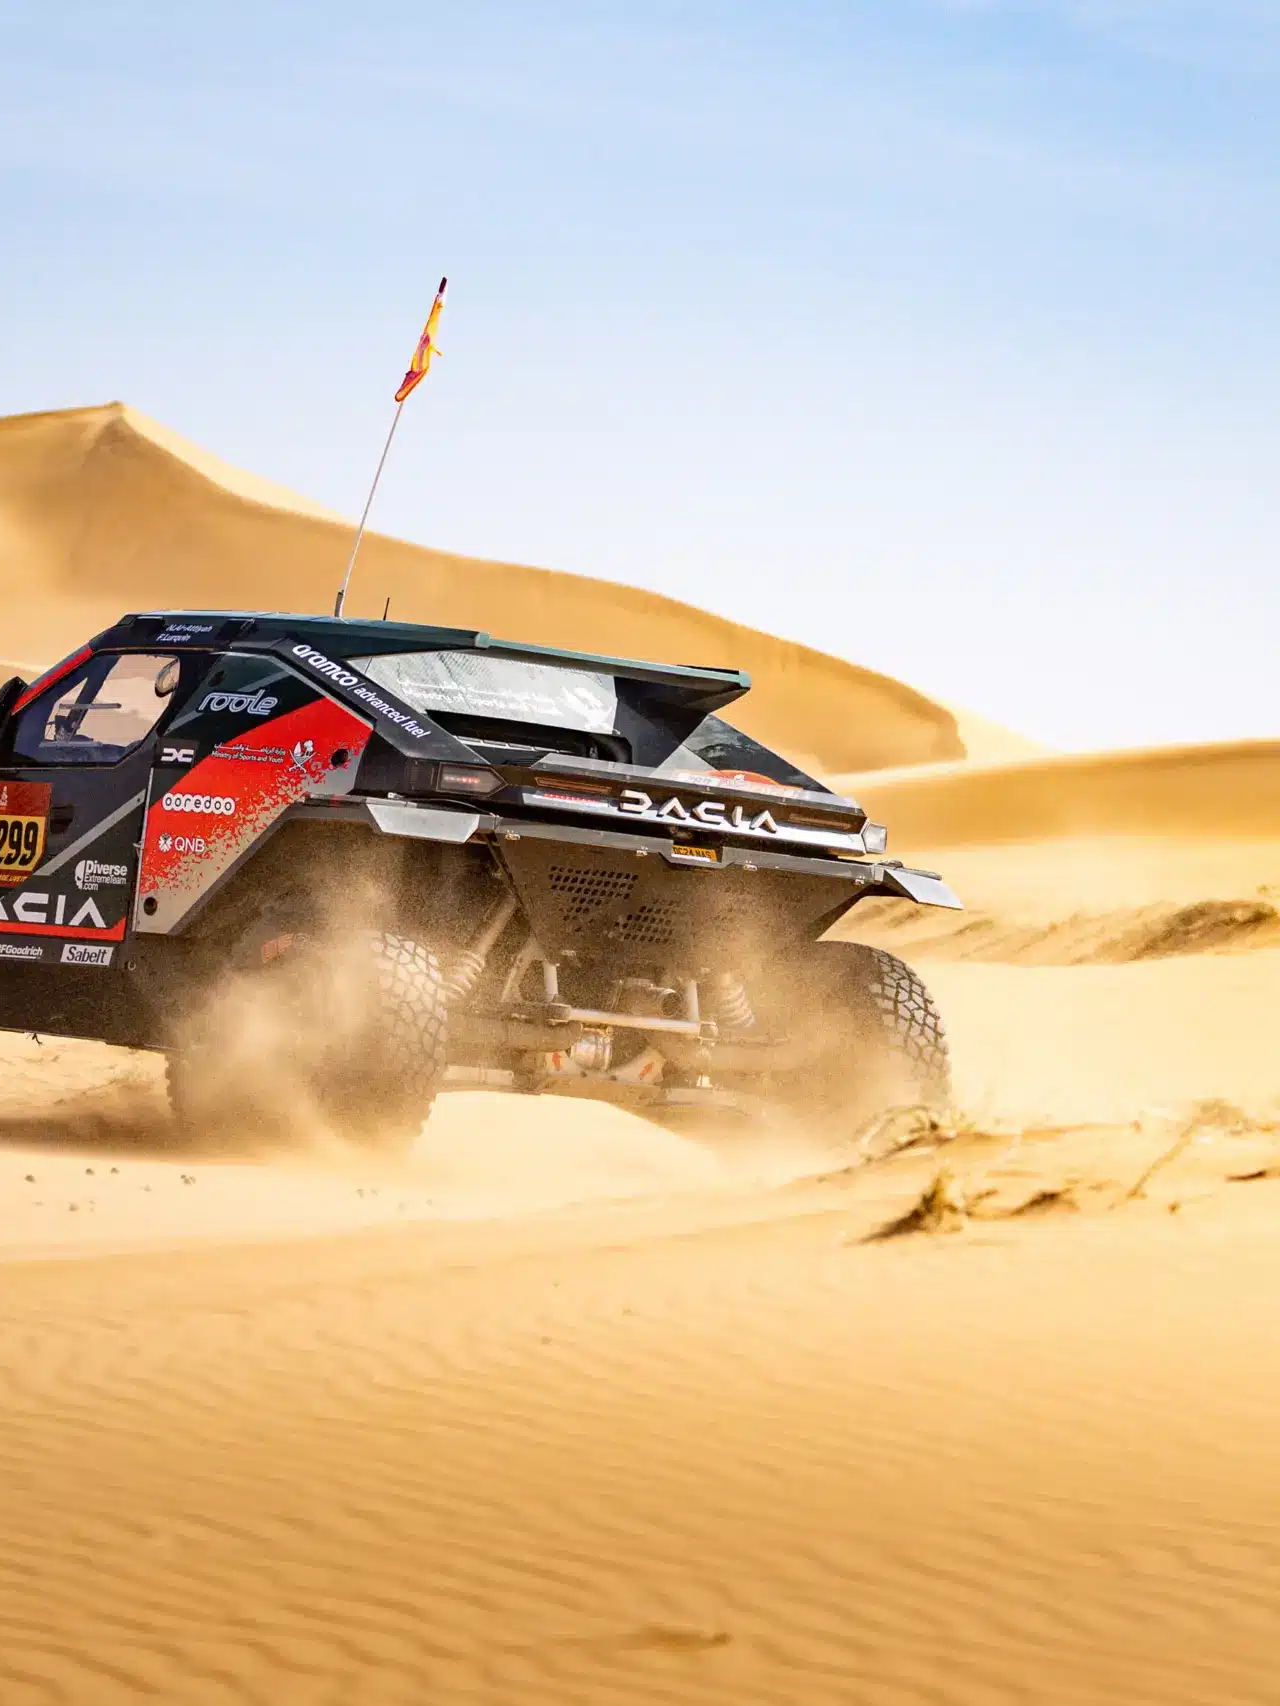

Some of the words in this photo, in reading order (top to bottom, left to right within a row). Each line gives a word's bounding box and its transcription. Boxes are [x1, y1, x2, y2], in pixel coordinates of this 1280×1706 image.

[292, 644, 358, 686] aramco
[353, 687, 409, 723] advanced
[401, 720, 431, 738] fuel
[211, 751, 232, 760] Ministry
[239, 753, 257, 761] Sports
[163, 793, 234, 814] ooredoo
[620, 789, 777, 833] DACIA
[174, 836, 205, 853] QNB
[86, 860, 128, 876] Diverse
[84, 874, 127, 885] ExtremeTeam
[66, 945, 108, 964] Sabelt
